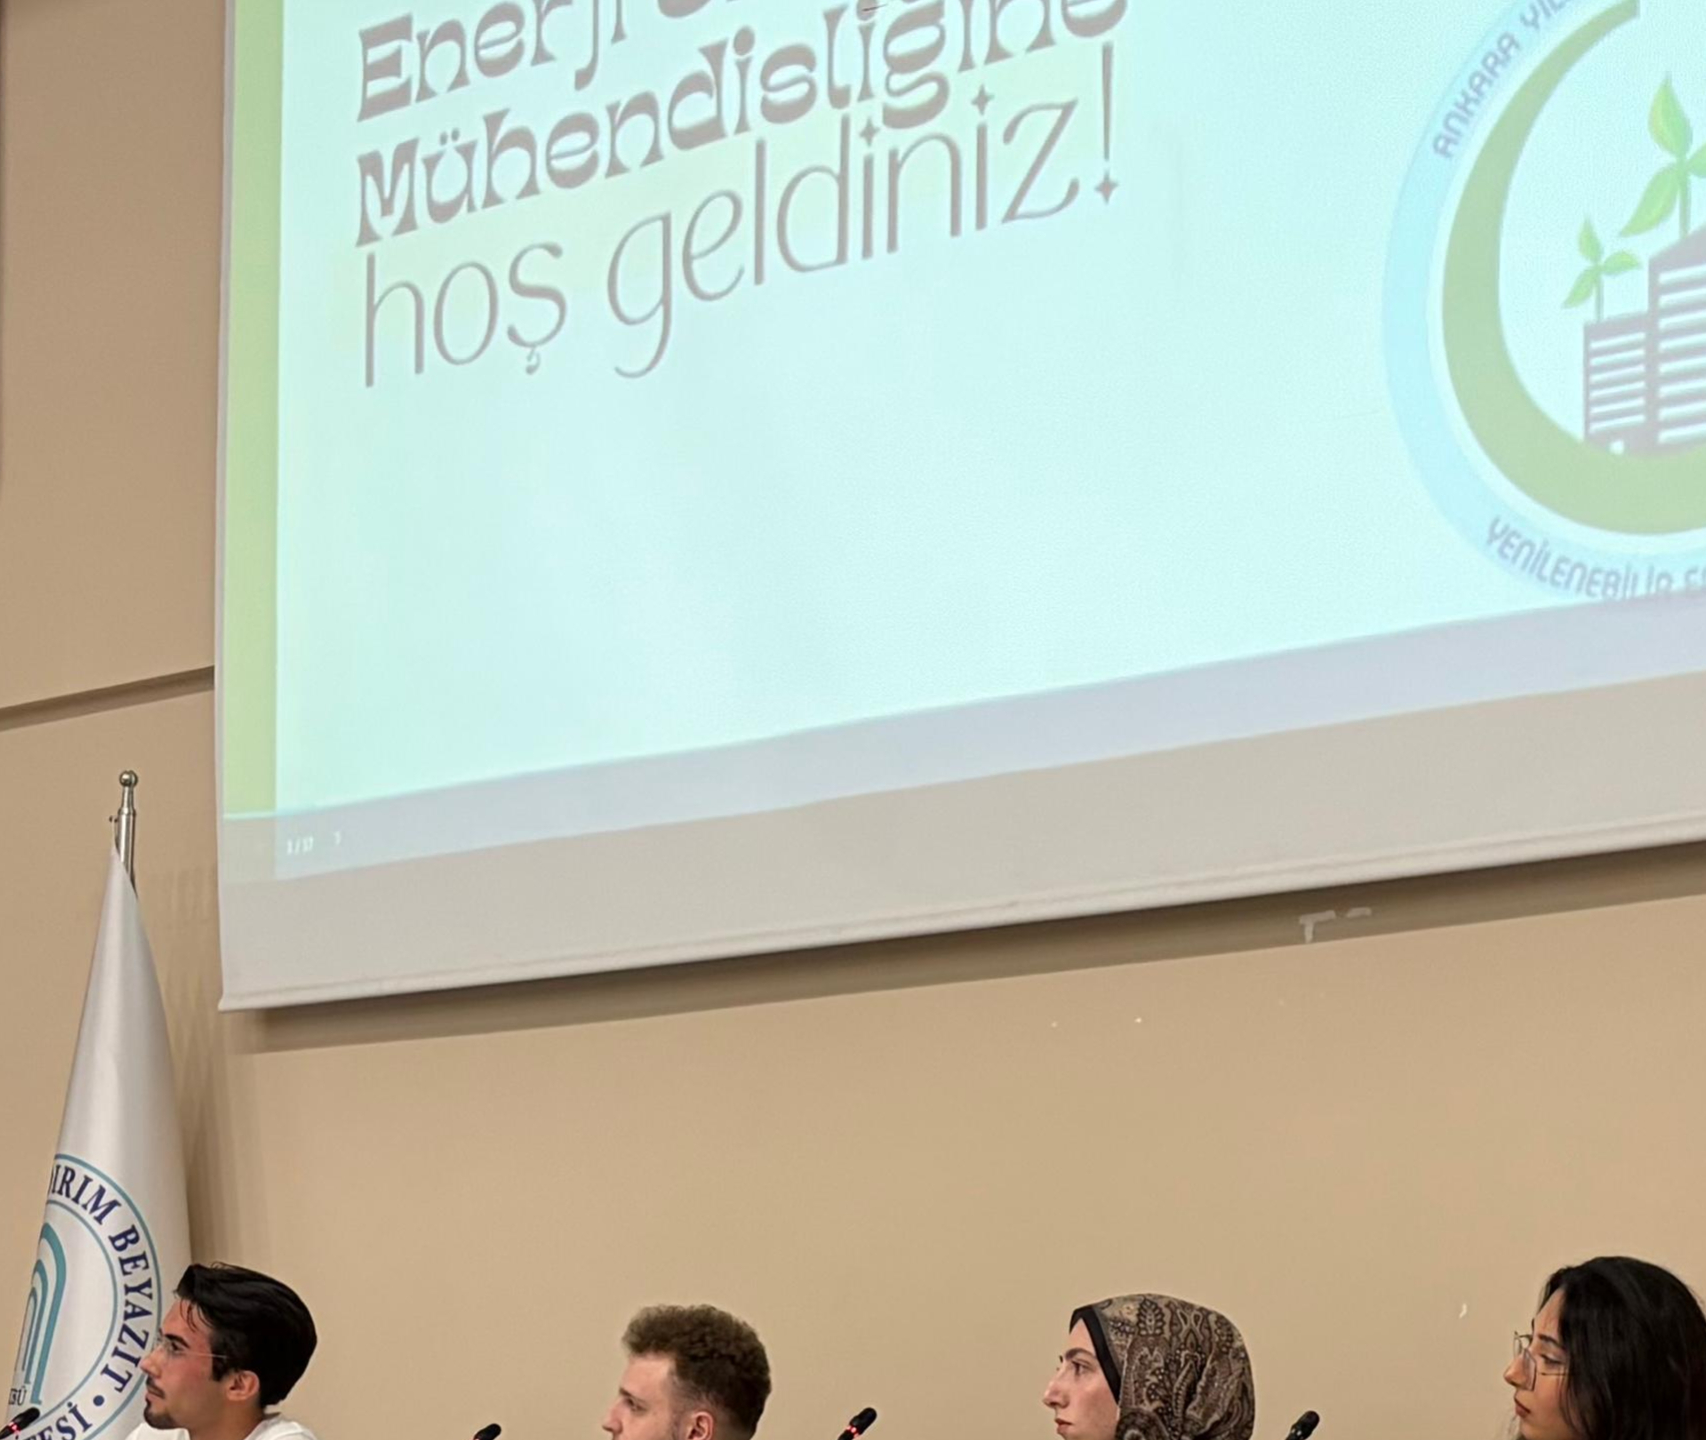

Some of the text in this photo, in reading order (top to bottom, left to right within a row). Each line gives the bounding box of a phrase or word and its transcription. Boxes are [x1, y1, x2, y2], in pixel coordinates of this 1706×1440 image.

[1433, 32, 1520, 158] ANKARA
[365, 41, 1119, 388] hoş geldiniz!
[100, 1224, 153, 1393] BEYAZIT
